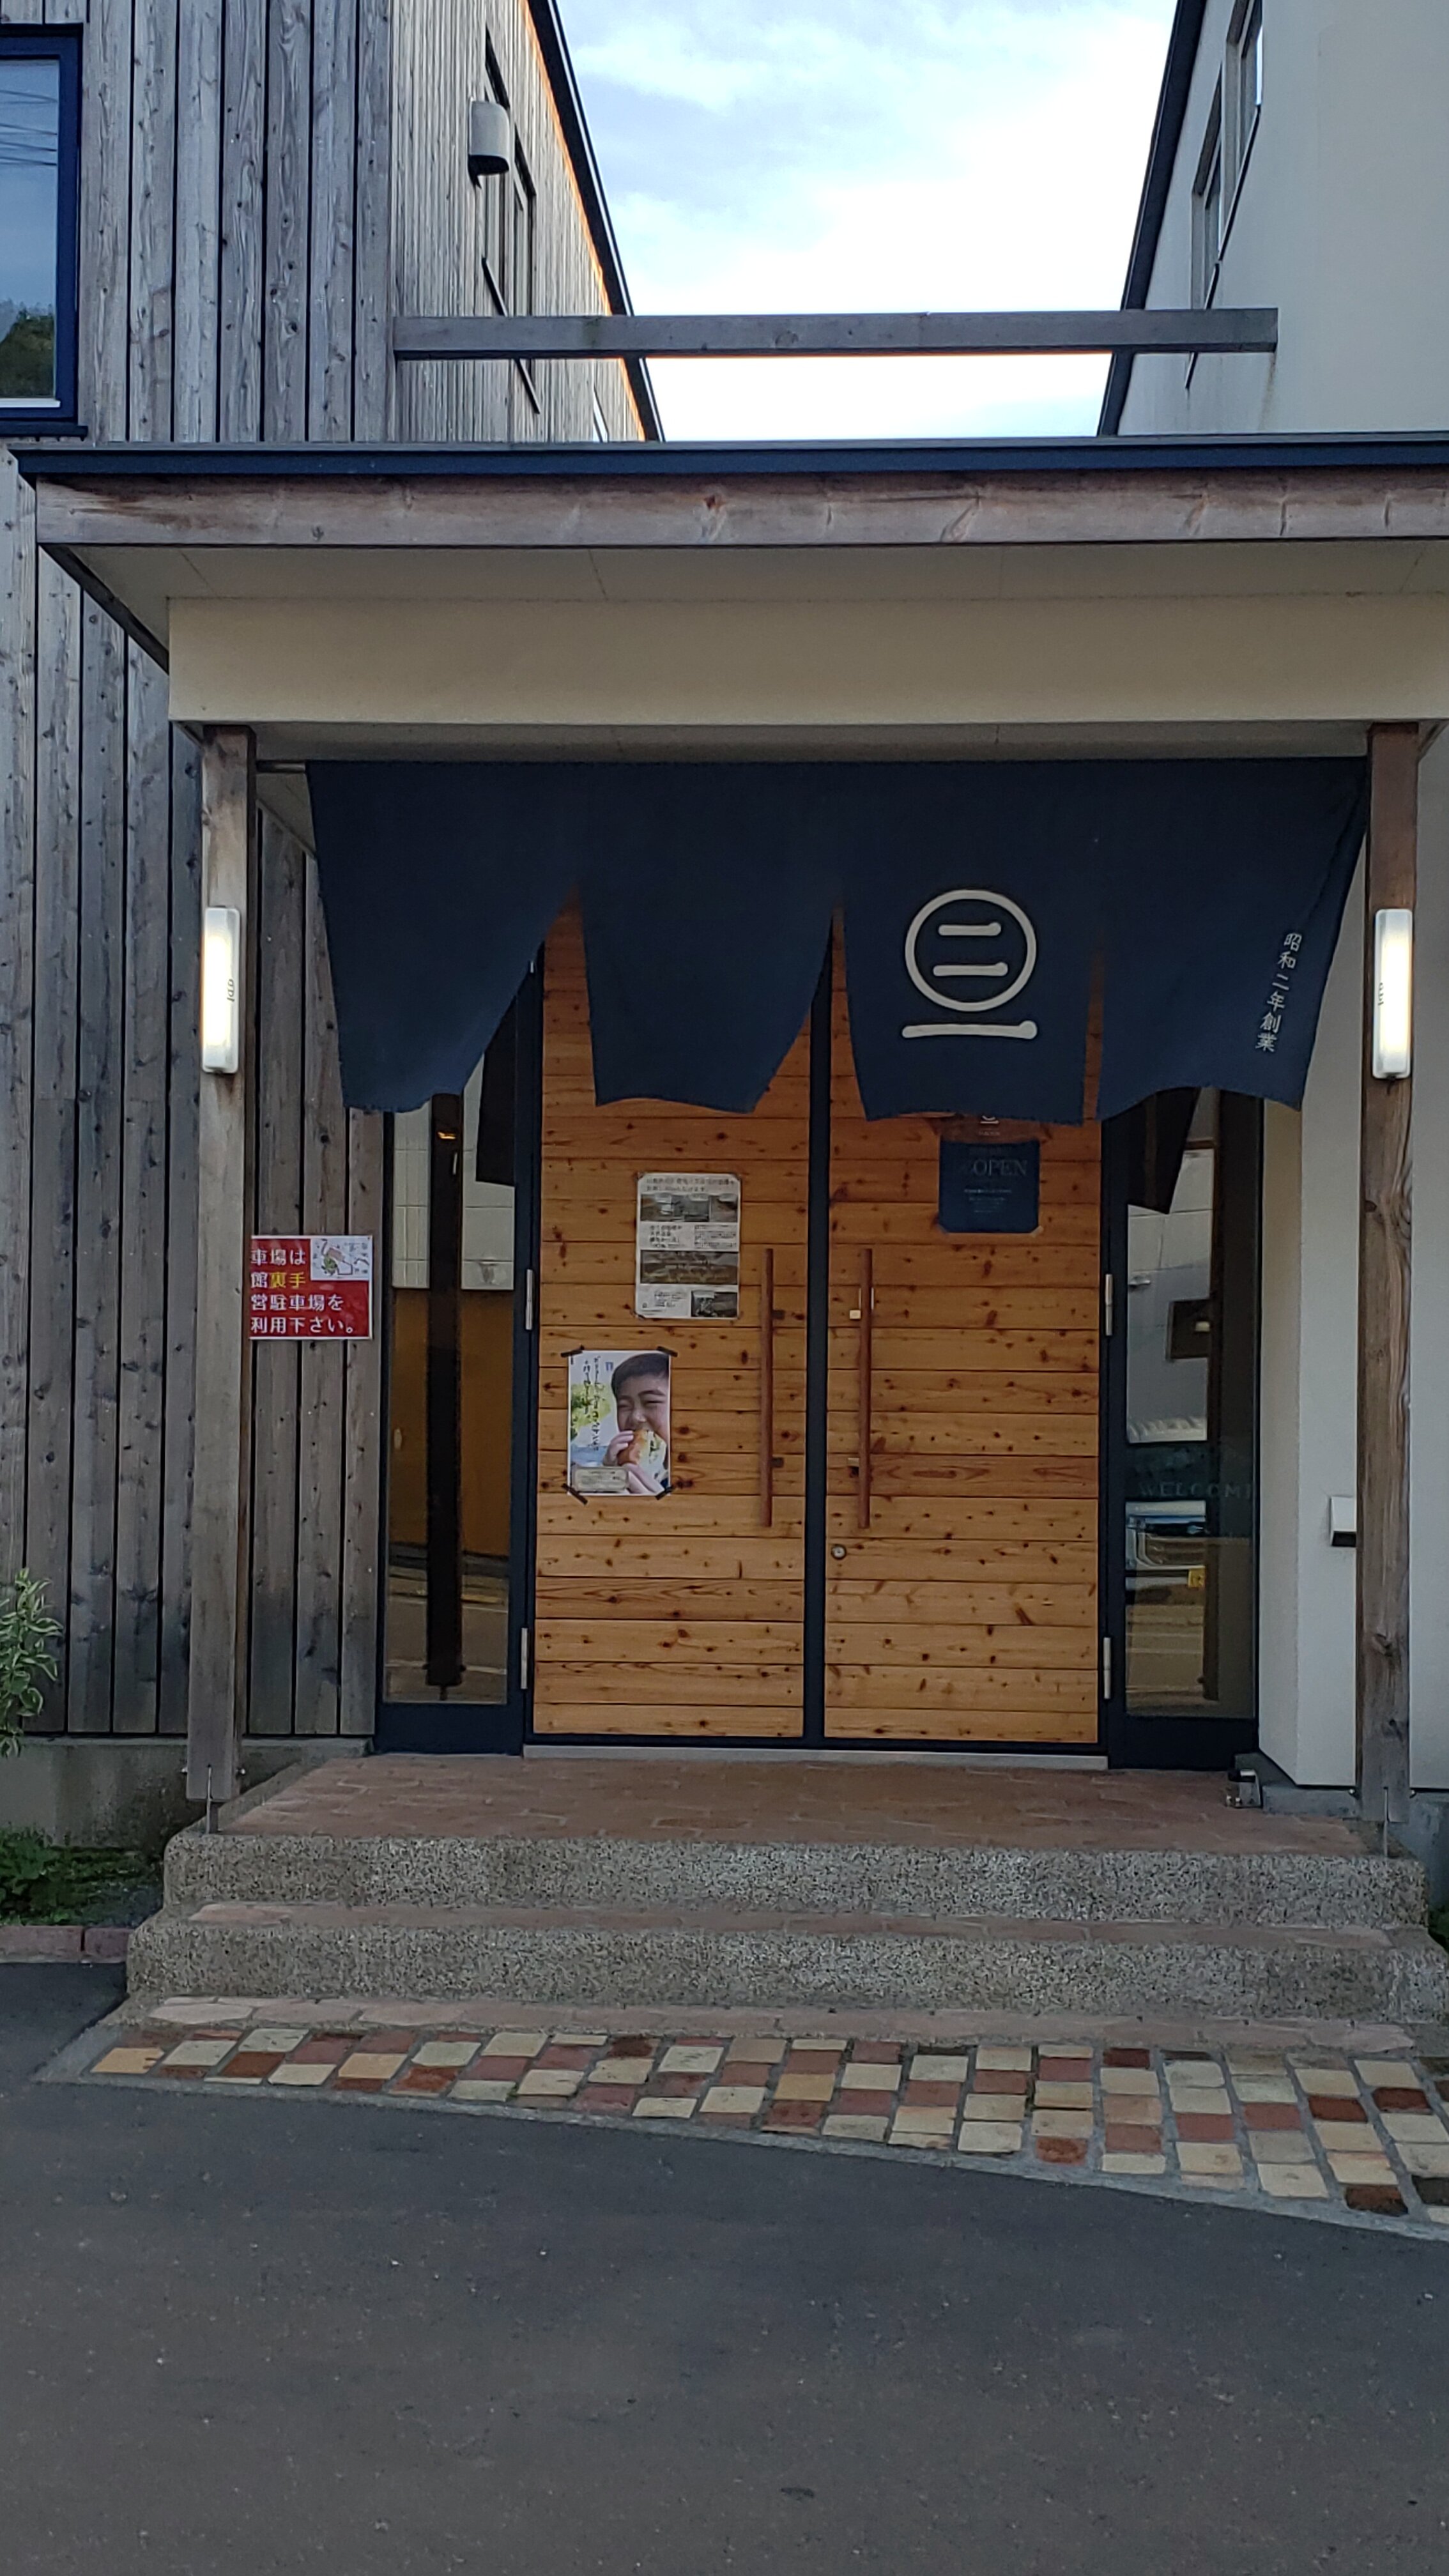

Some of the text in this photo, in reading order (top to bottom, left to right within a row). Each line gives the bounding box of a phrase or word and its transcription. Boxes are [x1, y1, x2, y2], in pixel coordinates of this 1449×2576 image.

[1254, 932, 1303, 1053] 昭和二年創業
[973, 1159, 1028, 1176] OPEN
[250, 1248, 306, 1266] 車場は
[250, 1271, 307, 1289] 館裏手
[250, 1292, 344, 1311] 営駐車場を
[250, 1316, 353, 1334] 利用下さい。
